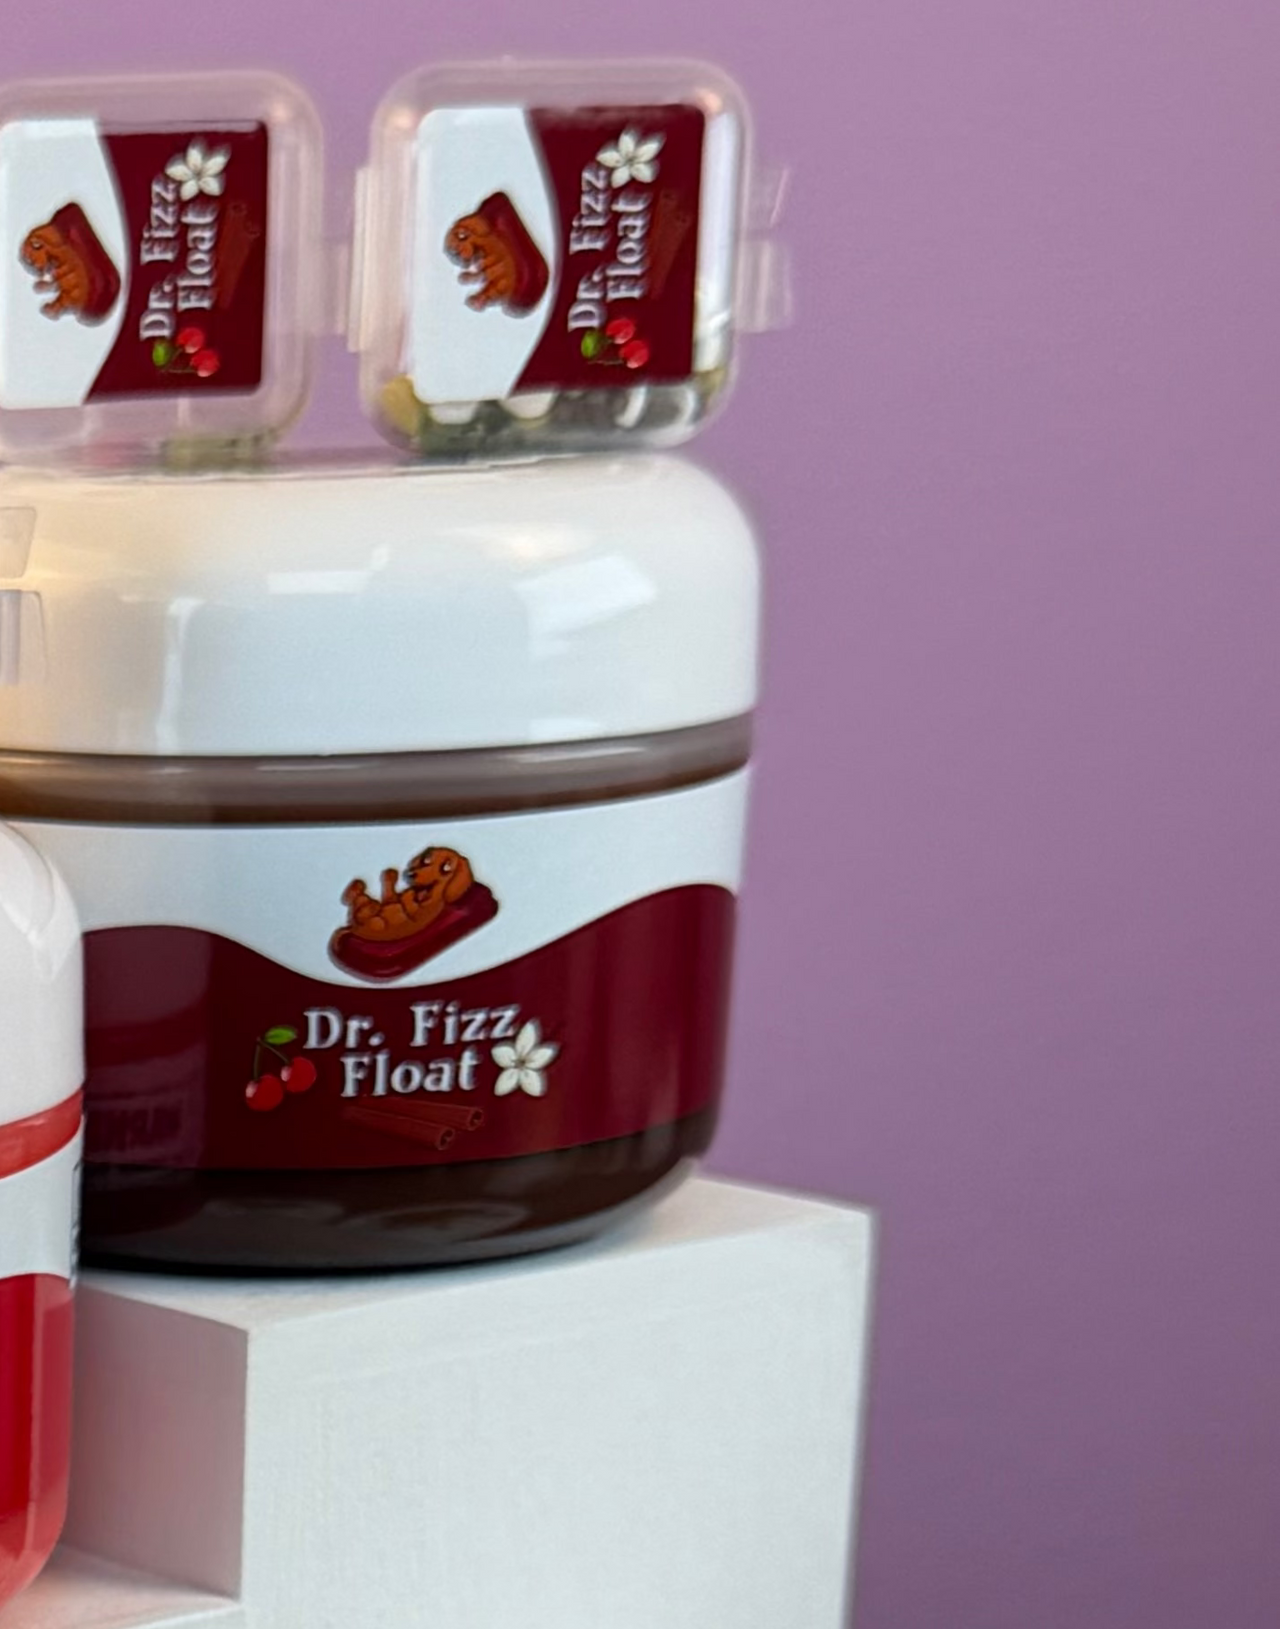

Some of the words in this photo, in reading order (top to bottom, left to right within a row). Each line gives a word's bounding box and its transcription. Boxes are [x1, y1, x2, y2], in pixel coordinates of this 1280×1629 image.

[140, 177, 178, 264] Fizz
[569, 166, 609, 255] Fizz
[606, 191, 649, 300] Float
[178, 202, 219, 312] Float
[139, 274, 175, 340] Dr.
[568, 265, 605, 332] Dr.
[303, 1006, 385, 1050] Dr.
[409, 1001, 520, 1047] Fizz
[340, 1048, 481, 1098] Float
